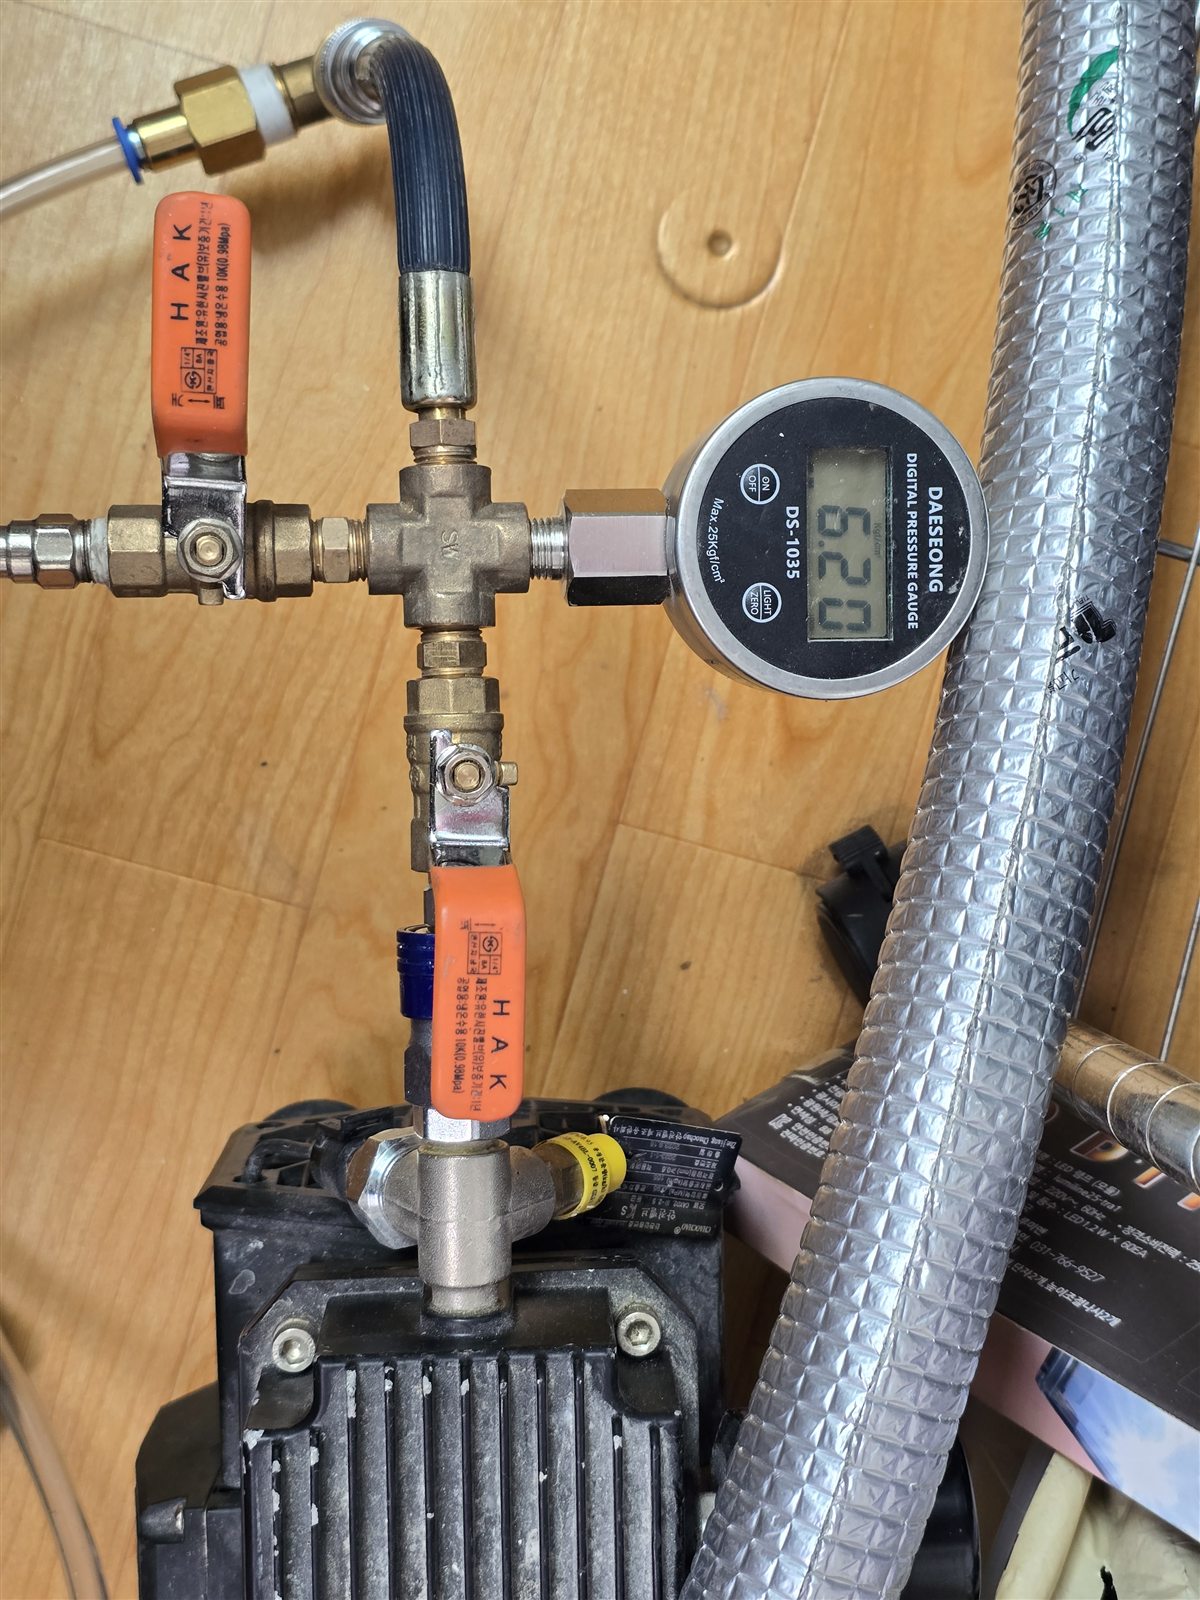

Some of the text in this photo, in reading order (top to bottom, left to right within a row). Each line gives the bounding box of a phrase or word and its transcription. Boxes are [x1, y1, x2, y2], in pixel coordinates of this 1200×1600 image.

[748, 475, 757, 492] OFF
[761, 476, 770, 491] ON
[786, 506, 799, 579] DS-1035
[906, 453, 918, 629] DIGITAL PRESSURE GAUGE
[928, 486, 943, 593] DAESEONG
[818, 505, 872, 633] 6.20
[750, 592, 759, 615] ZERO
[763, 590, 772, 615] LIGHT
[1054, 1160, 1073, 1172] LED
[1080, 1203, 1107, 1222] 60Hz
[1030, 1240, 1107, 1282] 031-766-9527
[1121, 1241, 1148, 1258] 60EA
